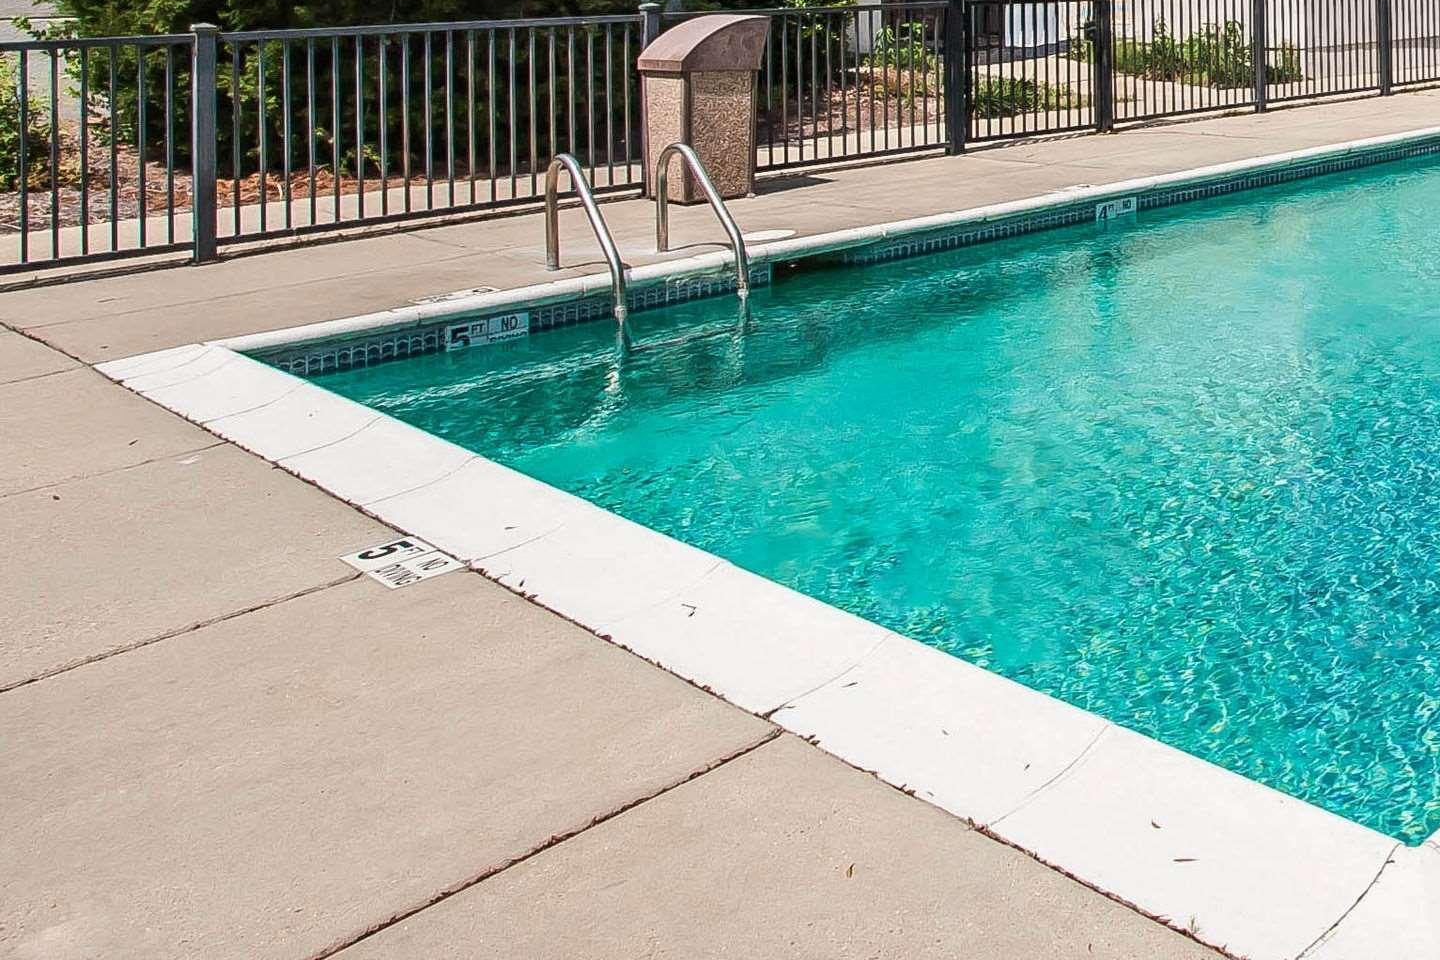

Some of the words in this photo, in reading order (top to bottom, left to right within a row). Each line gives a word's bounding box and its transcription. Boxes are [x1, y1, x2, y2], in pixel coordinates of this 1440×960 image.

[451, 326, 470, 348] 5
[472, 323, 485, 335] FT
[502, 316, 518, 331] NO
[358, 540, 414, 560] 5
[416, 557, 449, 572] NO
[374, 564, 422, 586] DIVING
